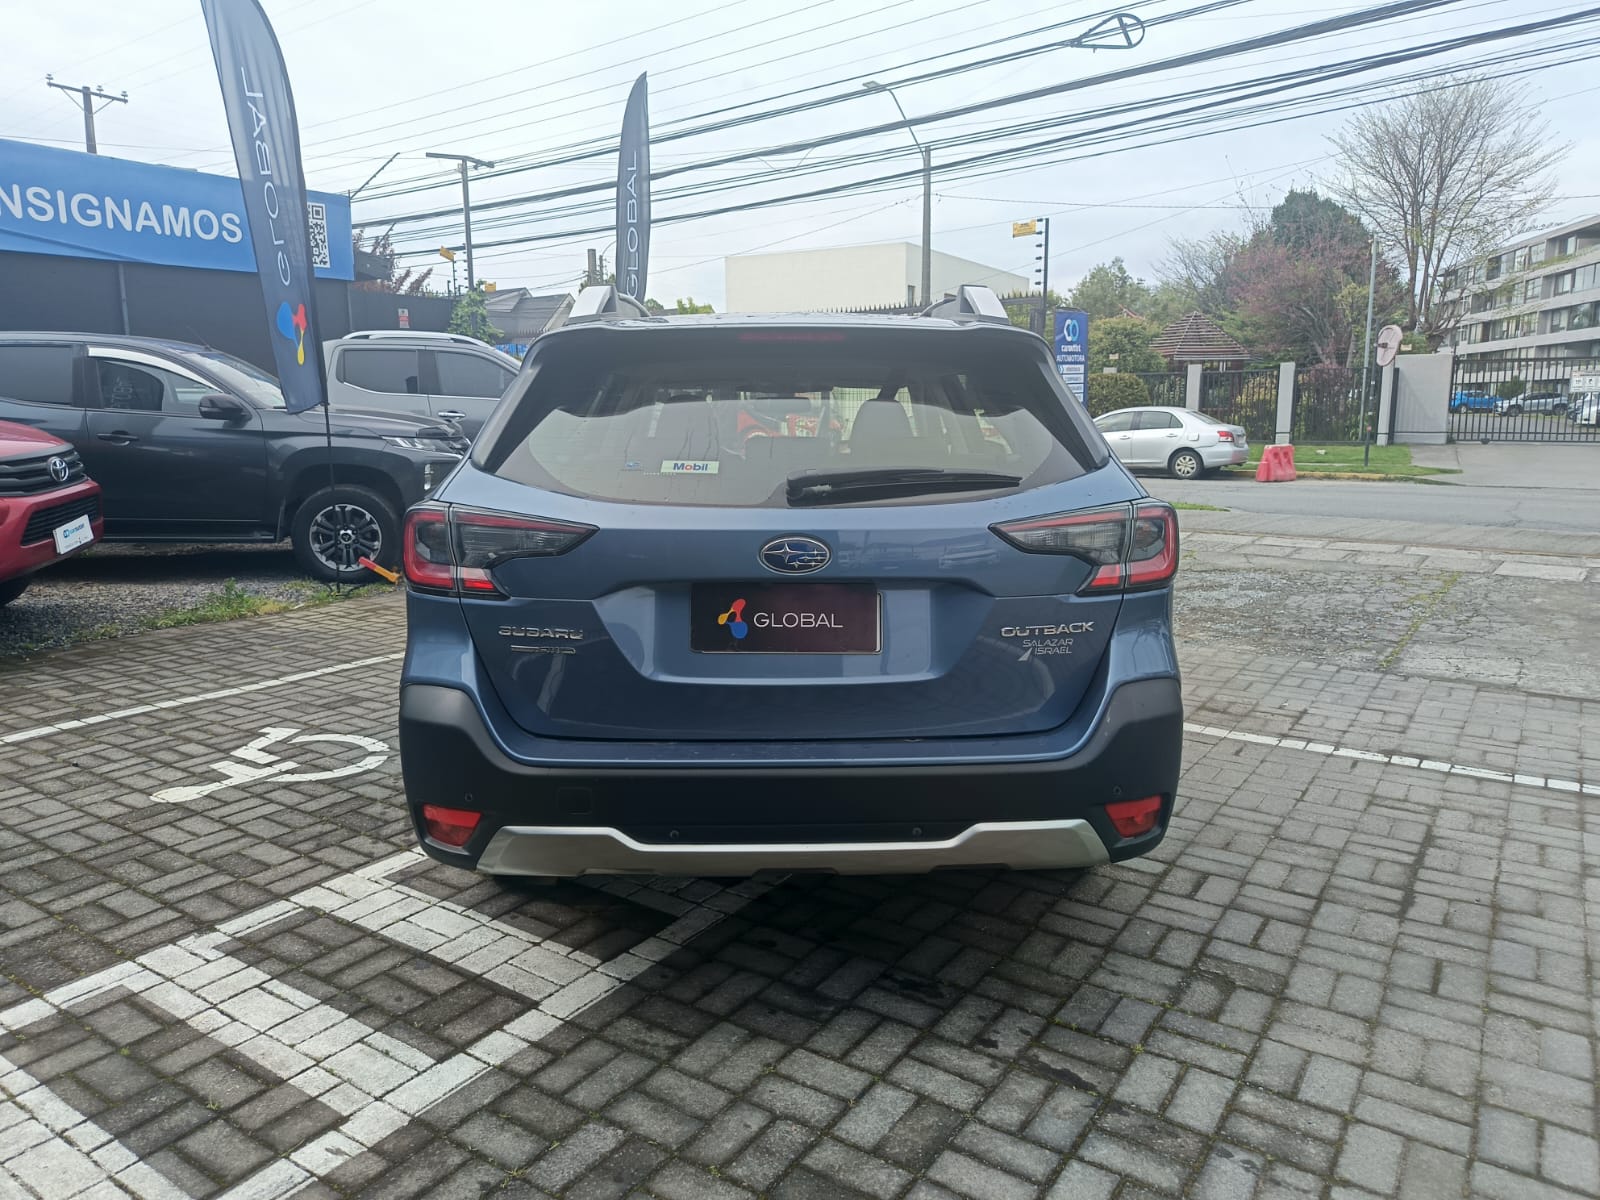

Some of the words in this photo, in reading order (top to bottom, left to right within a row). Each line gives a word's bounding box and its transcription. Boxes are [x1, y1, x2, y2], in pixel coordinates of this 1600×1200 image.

[240, 66, 291, 287] GLOBAL
[0, 183, 243, 244] NSIGNAMOS
[626, 151, 639, 299] GLOBAL
[673, 462, 709, 472] Mobil
[753, 612, 844, 628] GLOBAL
[498, 625, 584, 640] SUBARU
[1001, 621, 1095, 637] OUTBACK
[1022, 638, 1074, 648] SALAZAR
[1034, 646, 1073, 655] ISRAEL
